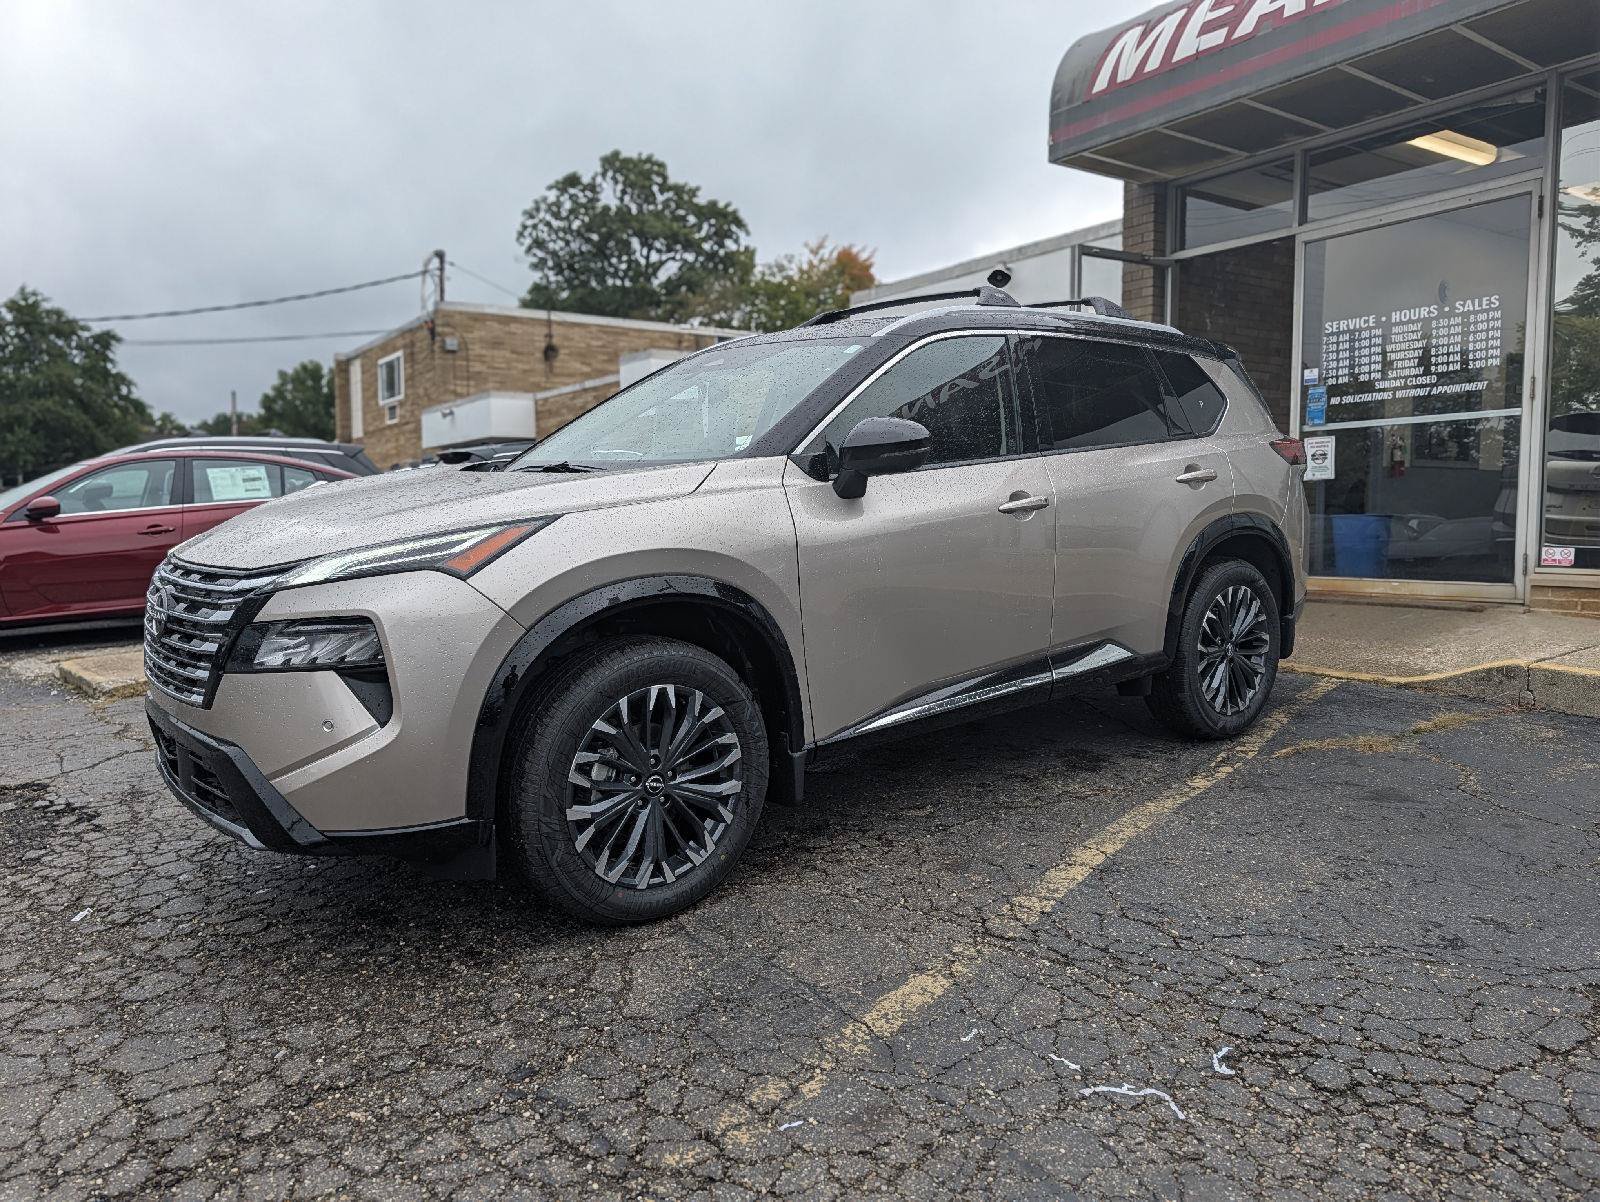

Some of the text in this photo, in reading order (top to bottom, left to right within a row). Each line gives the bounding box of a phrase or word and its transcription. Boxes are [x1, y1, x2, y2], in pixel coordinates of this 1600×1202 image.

[1325, 295, 1500, 333] SERVICE HOURS SALES
[1339, 333, 1349, 341] AM
[1371, 328, 1382, 337] PM
[1392, 322, 1422, 334] MONDAY
[1431, 319, 1448, 328] 8:30
[1449, 317, 1461, 325] AM
[1470, 313, 1487, 322] 8:00
[1489, 310, 1501, 319] PM
[1338, 341, 1349, 350] AM
[1371, 337, 1382, 346] PM
[1391, 331, 1422, 342] TUESDAY
[1431, 328, 1448, 337] 9:00
[1449, 325, 1461, 334] AM
[1470, 322, 1487, 332] 6:00
[1489, 320, 1501, 329] PM
[1339, 351, 1349, 359] AM
[1371, 346, 1382, 354] PM
[1386, 339, 1427, 352] WEDNESDAY
[1431, 337, 1448, 346] 9:00
[1449, 335, 1461, 343] AM
[1469, 332, 1487, 341] 6:00
[1489, 330, 1501, 338] PM
[1339, 359, 1349, 367] AM
[1371, 355, 1382, 363] PM
[1387, 349, 1423, 361] THURSDAY
[1431, 346, 1447, 355] 8:30
[1449, 344, 1460, 352] AM
[1469, 341, 1486, 350] 8:00
[1488, 339, 1500, 348] PM
[1371, 363, 1382, 371] PM
[1394, 359, 1419, 369] FRIDAY
[1431, 355, 1447, 364] 9:00
[1449, 353, 1460, 362] AM
[1469, 351, 1486, 360] 6:00
[1488, 348, 1500, 357] PM
[1338, 376, 1349, 384] AM
[1371, 372, 1382, 380] PM
[1388, 366, 1424, 378] SATURDAY
[1431, 364, 1447, 373] 9:00
[1448, 362, 1460, 371] AM
[1488, 358, 1500, 367] PM
[1375, 375, 1437, 389] SUNDAY CLOSED
[1330, 396, 1341, 405] NO
[1341, 391, 1393, 404] SOLICITATIONS
[1396, 387, 1431, 398] WITHOUT
[1431, 381, 1488, 395] APPOINTMENT
